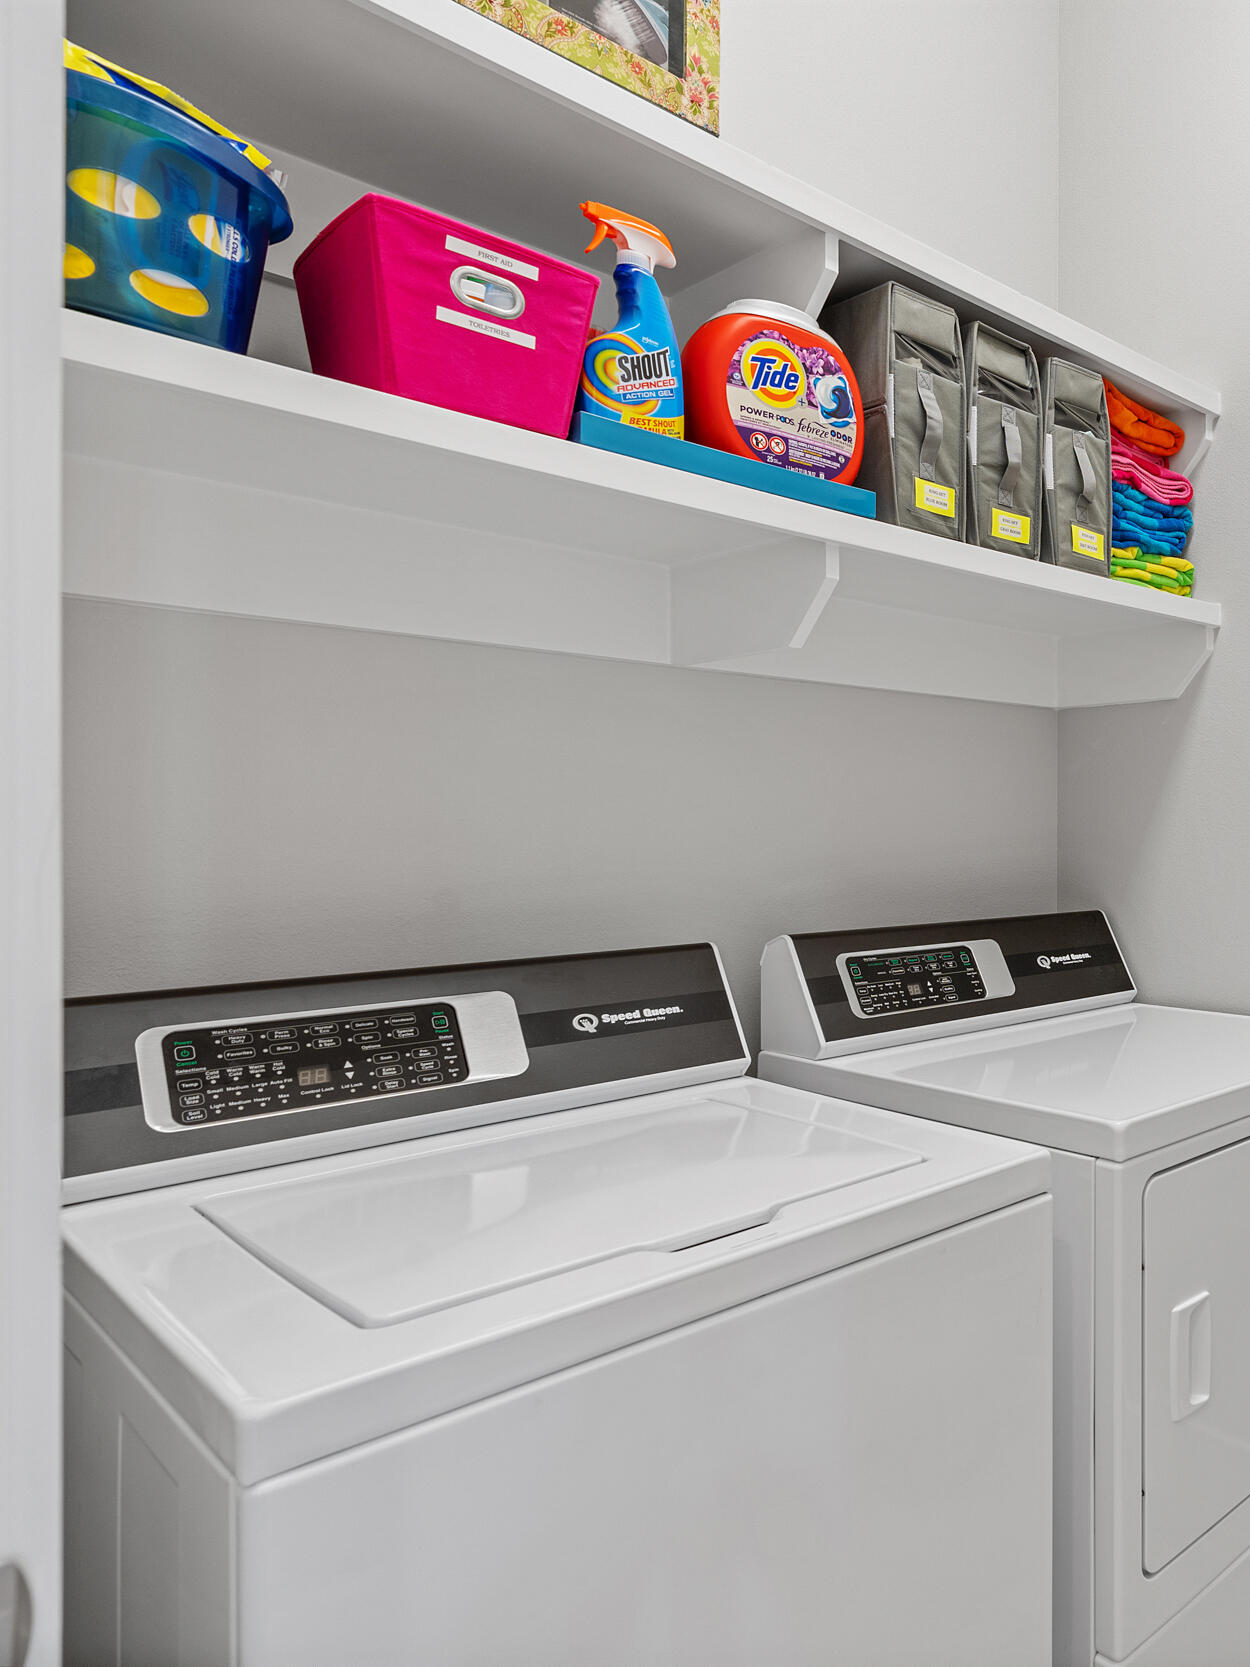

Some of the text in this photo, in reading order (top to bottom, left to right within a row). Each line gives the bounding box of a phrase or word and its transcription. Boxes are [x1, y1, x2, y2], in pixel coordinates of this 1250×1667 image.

[478, 250, 512, 268] FIRST AID
[469, 320, 510, 338] TOILETRIES
[618, 348, 670, 382] SHOUT
[750, 356, 800, 390] Tide
[616, 378, 675, 392] ADVANCED
[626, 391, 656, 399] ACTION
[628, 417, 676, 428] BEST SHOUT
[740, 405, 774, 420] POWER
[776, 414, 794, 426] PODS
[796, 418, 829, 438] febreze
[830, 430, 852, 444] ODOR
[1050, 954, 1070, 964] Speed
[601, 1010, 640, 1024] Speed
[175, 1067, 206, 1075] Selections
